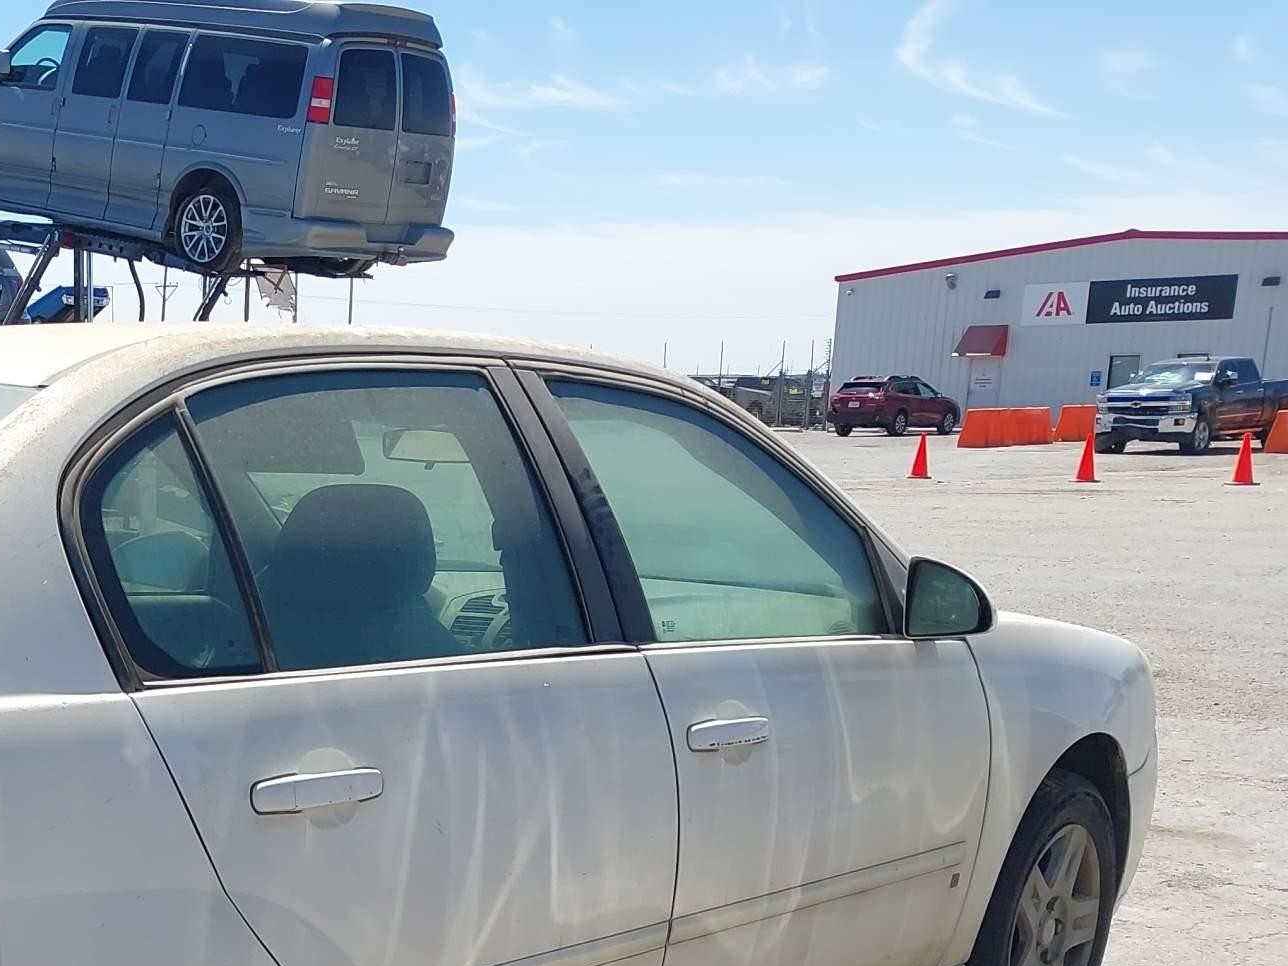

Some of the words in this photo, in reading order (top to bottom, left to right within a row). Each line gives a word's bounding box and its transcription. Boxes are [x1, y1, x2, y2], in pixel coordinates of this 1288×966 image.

[1126, 284, 1196, 298] Insurance
[1110, 301, 1142, 316] Auto
[1146, 299, 1209, 315] Auctions
